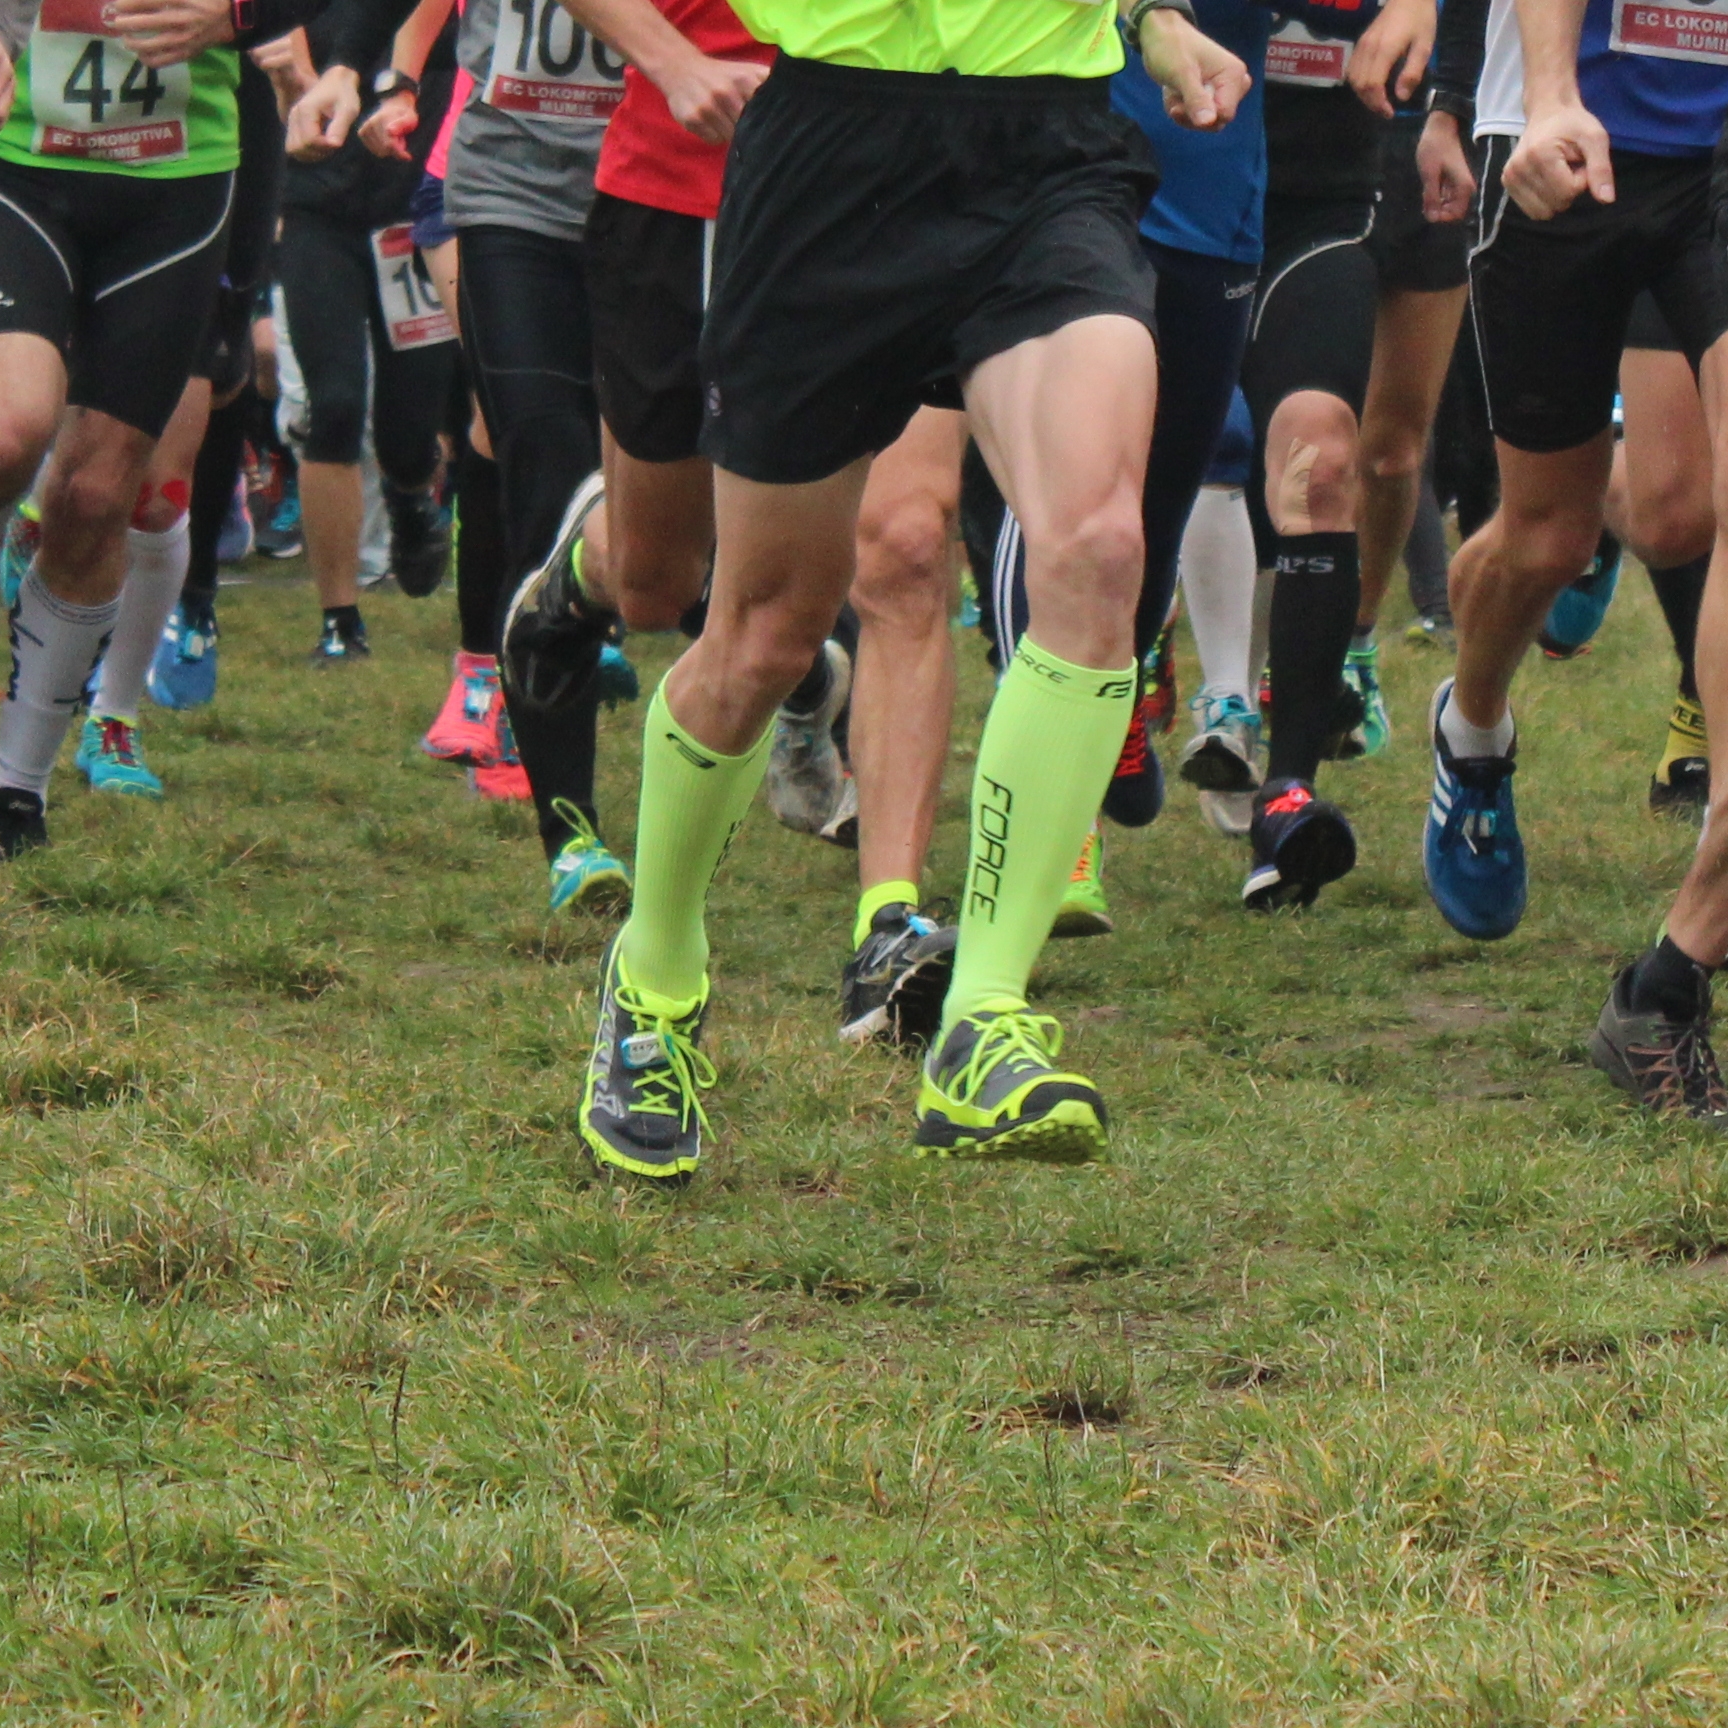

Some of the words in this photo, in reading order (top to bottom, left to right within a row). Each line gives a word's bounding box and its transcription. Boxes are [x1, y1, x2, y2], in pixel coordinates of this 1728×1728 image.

[1634, 10, 1660, 27] EC
[1267, 45, 1335, 63] OMOTIVA
[62, 39, 167, 124] 44
[502, 81, 524, 96] EC
[527, 84, 625, 103] LOKOMOTIV
[538, 100, 595, 115] MUMIE
[52, 132, 75, 146] EC
[78, 126, 174, 148] LOKOMOTIVA
[1013, 646, 1071, 684] ORCE
[971, 773, 1013, 924] FORCE
